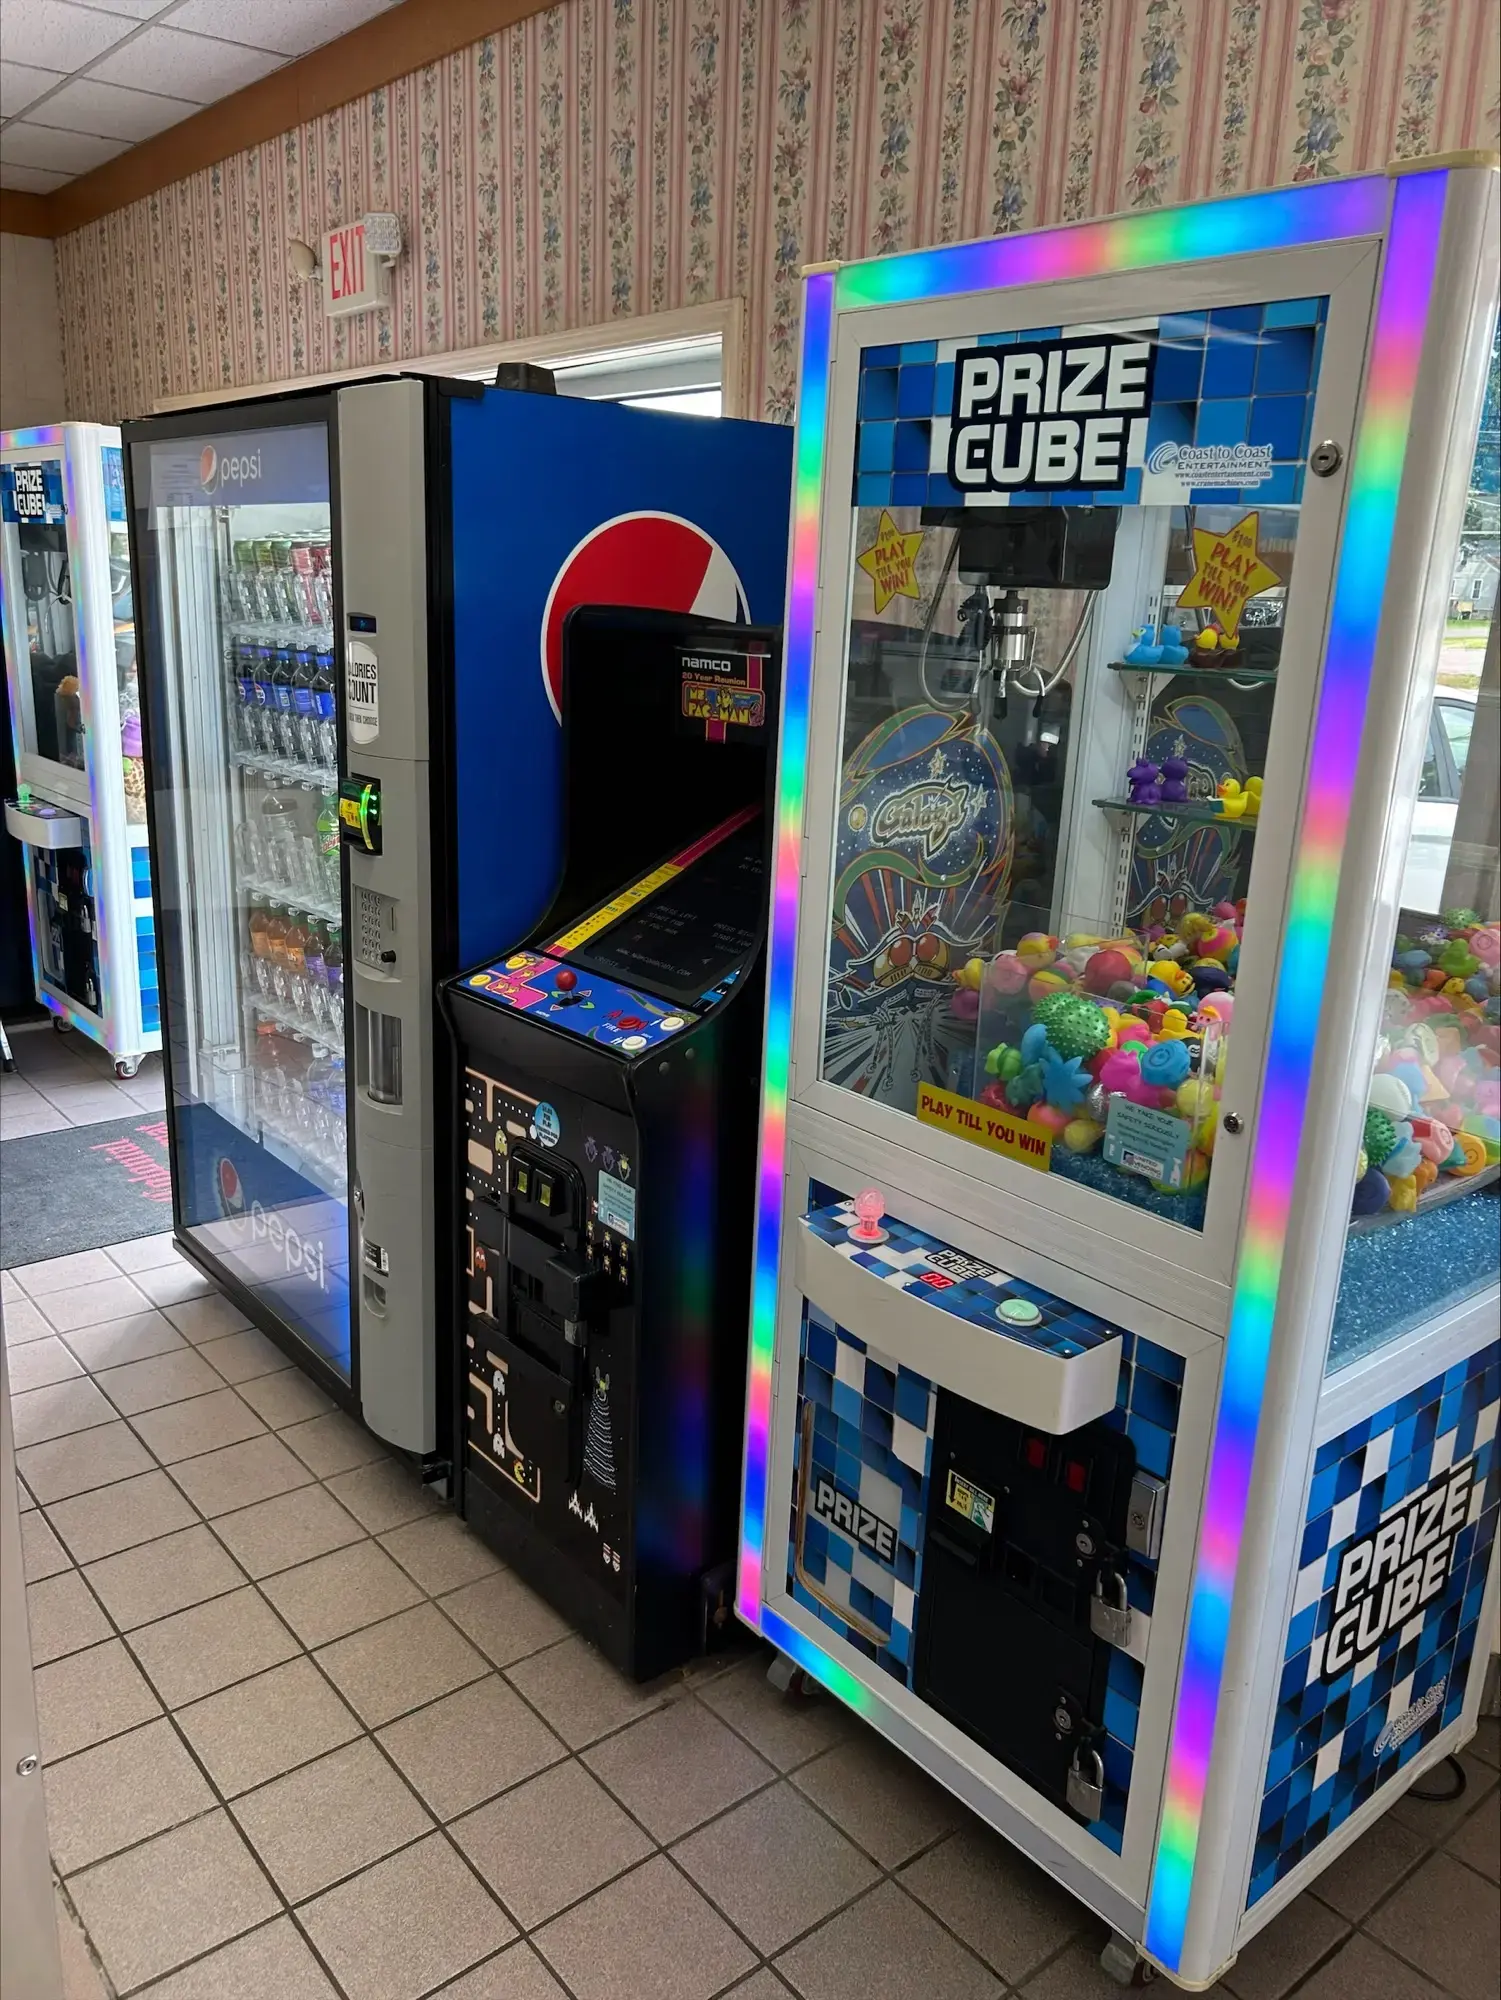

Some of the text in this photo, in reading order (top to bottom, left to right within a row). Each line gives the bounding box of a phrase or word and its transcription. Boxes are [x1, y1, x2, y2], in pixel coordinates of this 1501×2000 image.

[330, 225, 364, 300] EXIT
[957, 342, 1152, 418] PRIZE
[955, 417, 1124, 484] CUBE
[1179, 443, 1273, 460] Coast to Coast
[220, 448, 262, 488] pepsi
[1177, 460, 1271, 470] ENTERTAINMENT
[14, 469, 43, 492] PRIZE
[17, 493, 43, 515] CUBE
[874, 539, 906, 566] PLAY
[1210, 542, 1257, 580] PLAY
[876, 557, 911, 580] TILL YOU
[880, 569, 910, 594] WIN!
[1203, 561, 1249, 597] TILL YOU
[1198, 576, 1239, 614] WIN!
[681, 656, 731, 672] namco
[682, 671, 746, 686] 20 Year Reunion
[688, 702, 750, 724] PAC-MAN
[874, 785, 968, 850] Galaga
[601, 1022, 621, 1033] FIRE
[920, 1094, 1046, 1157] PLAY TILL YOU WIN
[1116, 1111, 1142, 1125] SAFETY
[251, 1199, 325, 1290] pepsi
[927, 1254, 978, 1280] CUBE
[937, 1249, 995, 1278] PRIZE
[919, 1273, 955, 1289] 00
[818, 1480, 895, 1560] PRIZE
[1334, 1466, 1474, 1614] PRIZE
[1325, 1534, 1452, 1675] CUBE
